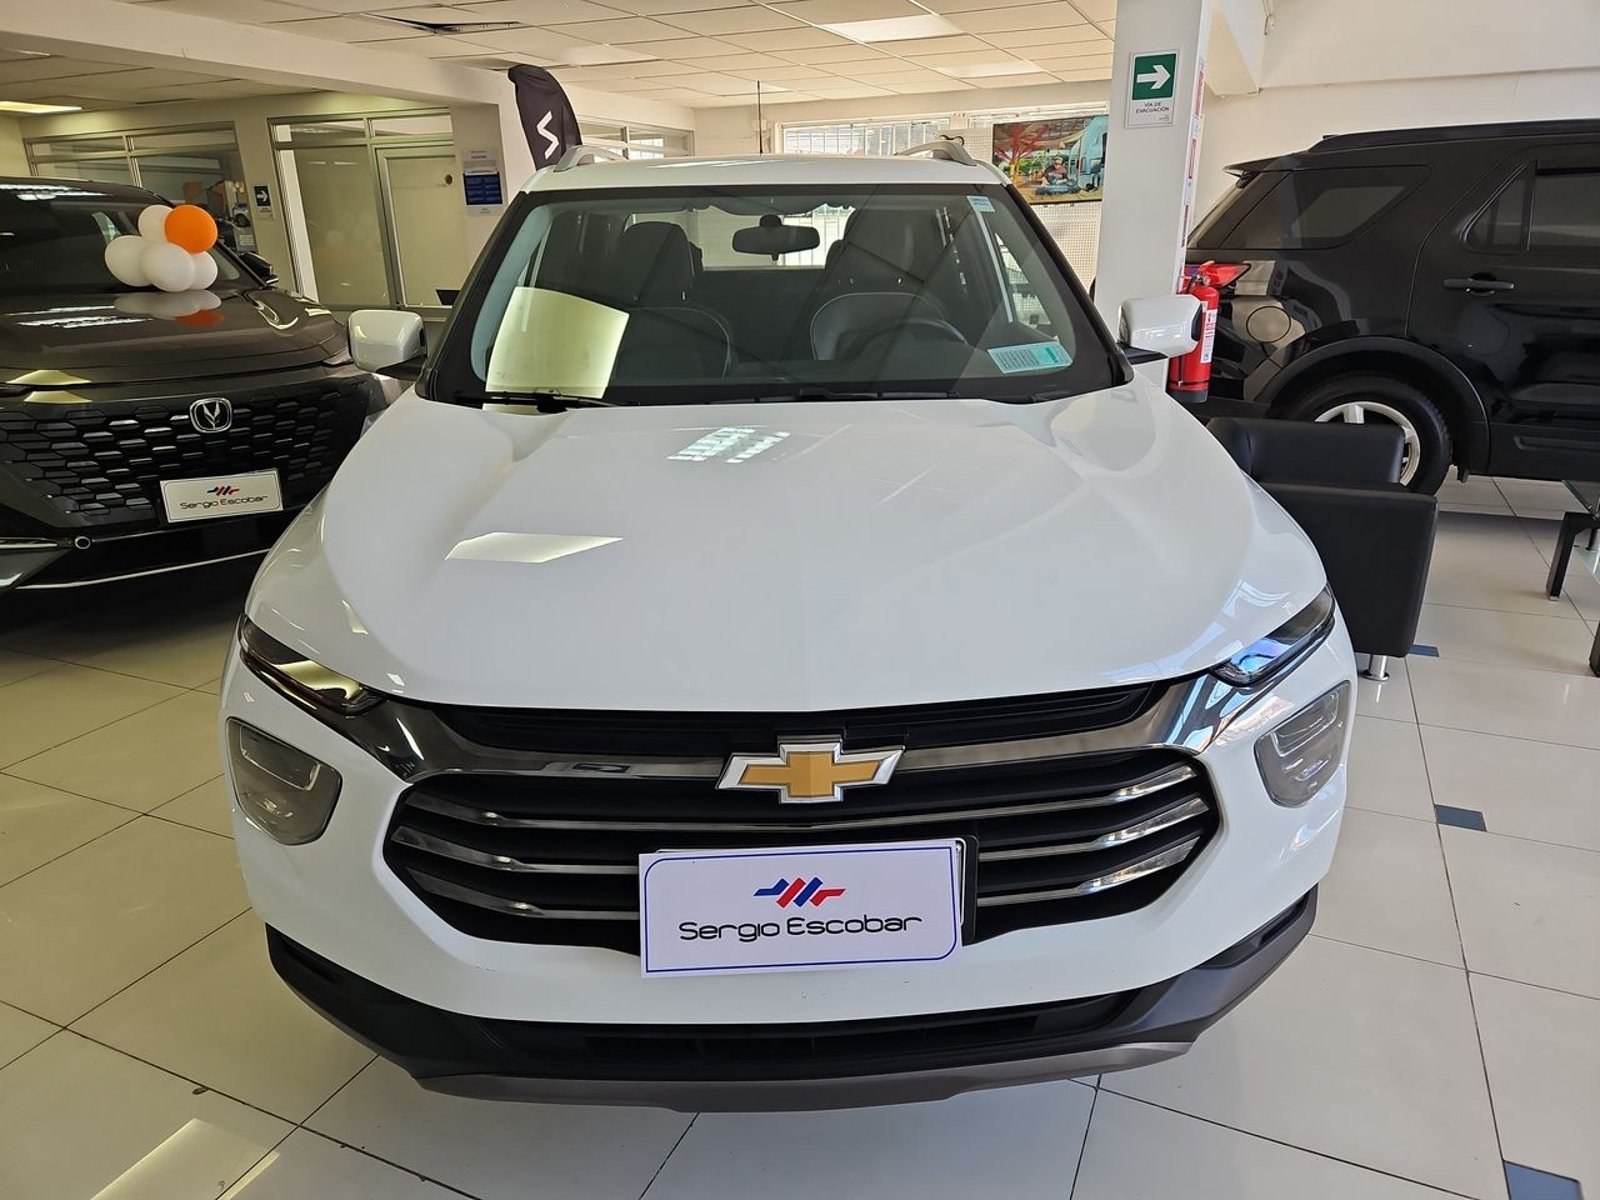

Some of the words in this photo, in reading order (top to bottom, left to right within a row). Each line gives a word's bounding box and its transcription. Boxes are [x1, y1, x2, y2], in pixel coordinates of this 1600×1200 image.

[220, 495, 268, 506] Escobar
[678, 921, 780, 942] Sergio
[786, 914, 922, 936] Escobar
